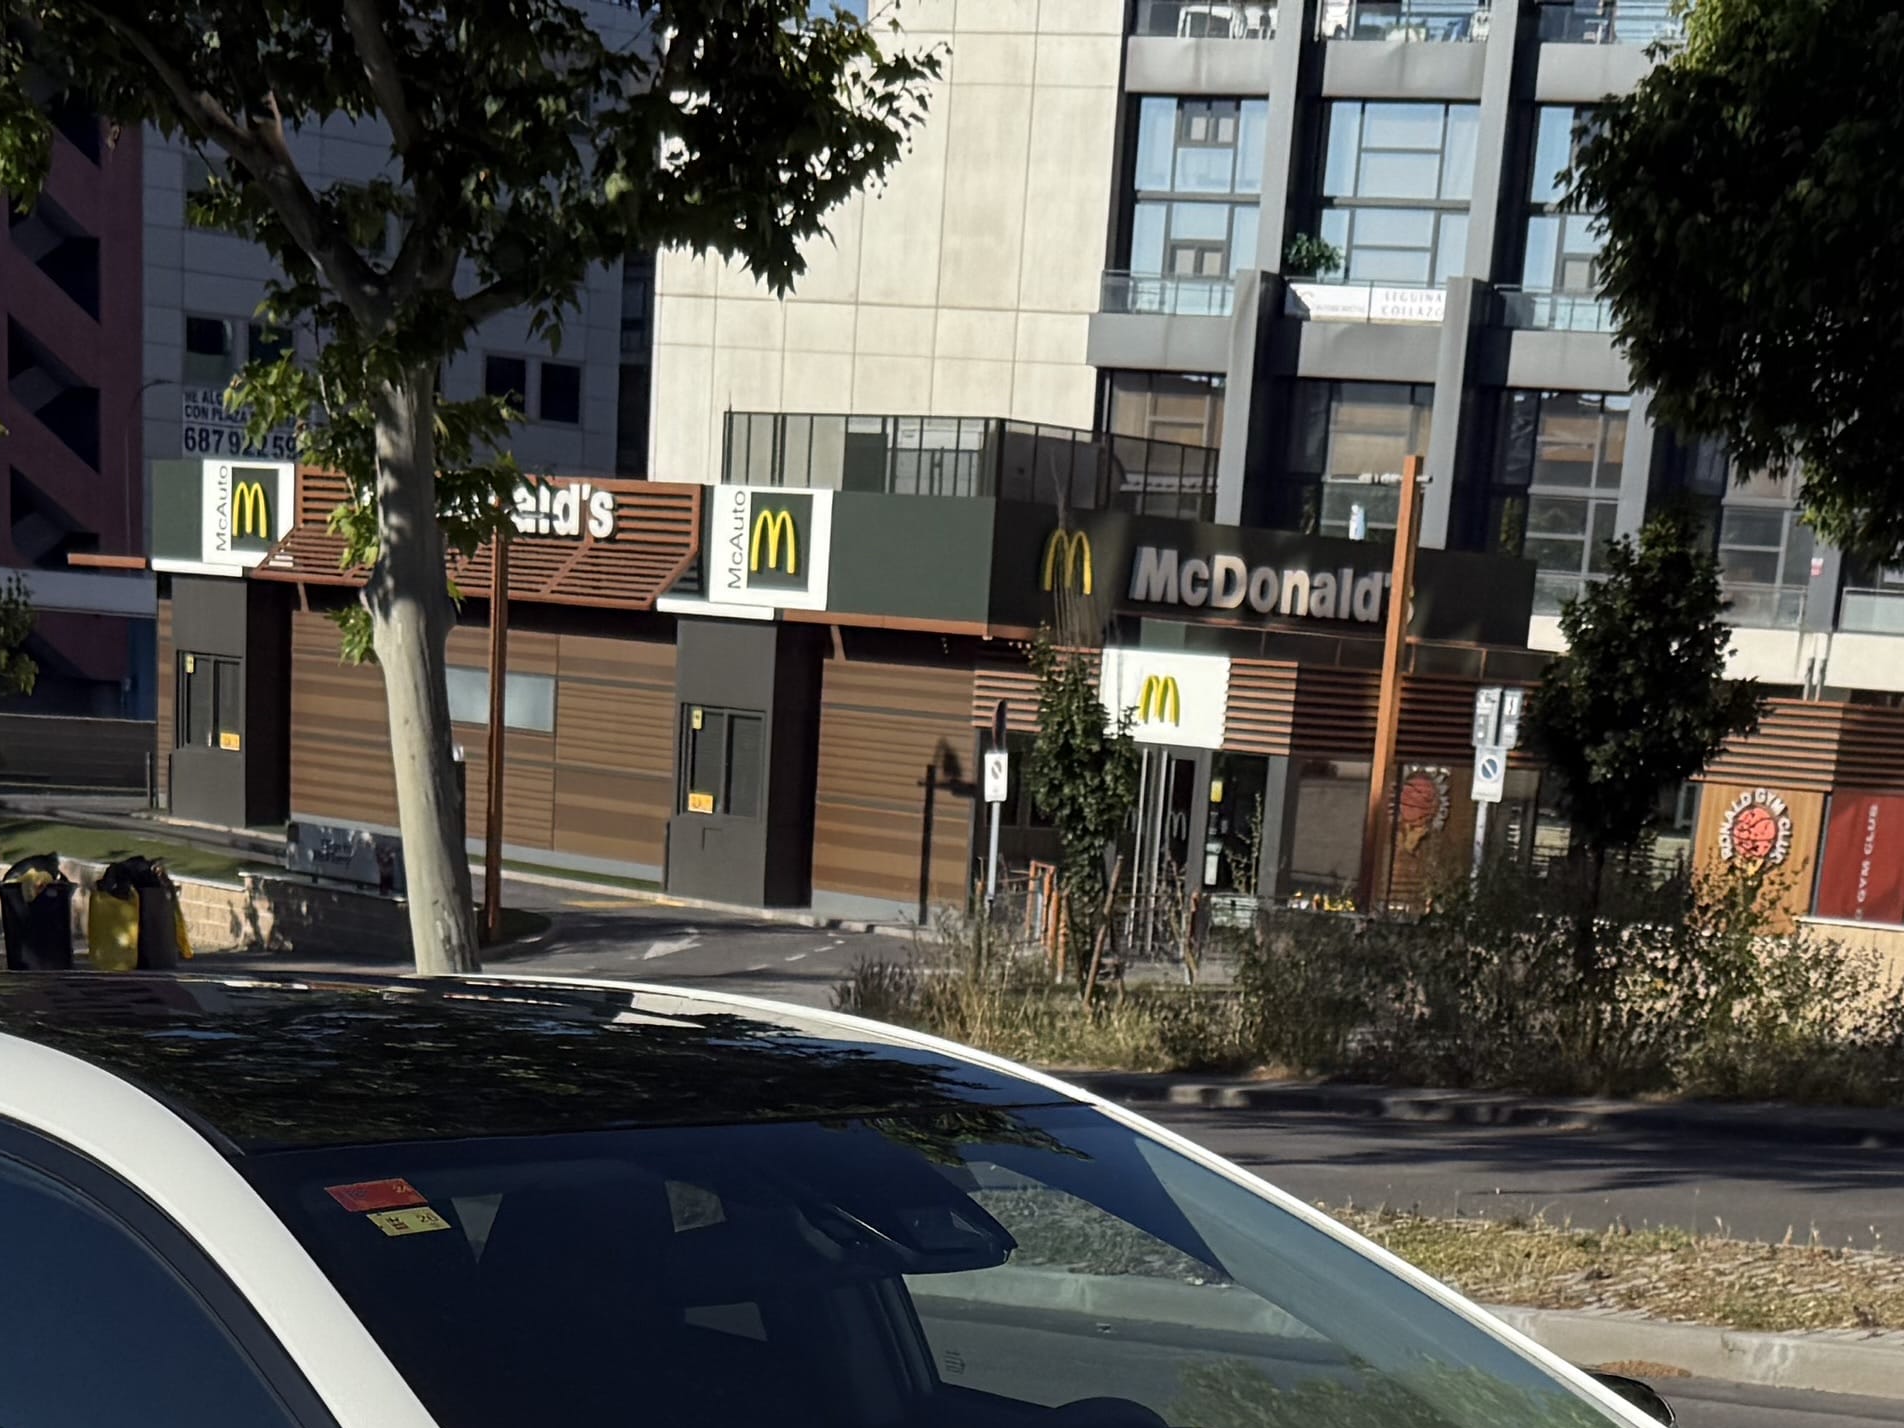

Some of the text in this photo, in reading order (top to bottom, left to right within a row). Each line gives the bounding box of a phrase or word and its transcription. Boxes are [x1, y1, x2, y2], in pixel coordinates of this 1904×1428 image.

[184, 427, 224, 454] 687
[217, 465, 228, 551] McAuto
[728, 489, 747, 590] McAuto
[1129, 546, 1415, 624] McDonald'
[1754, 787, 1787, 816] GYM
